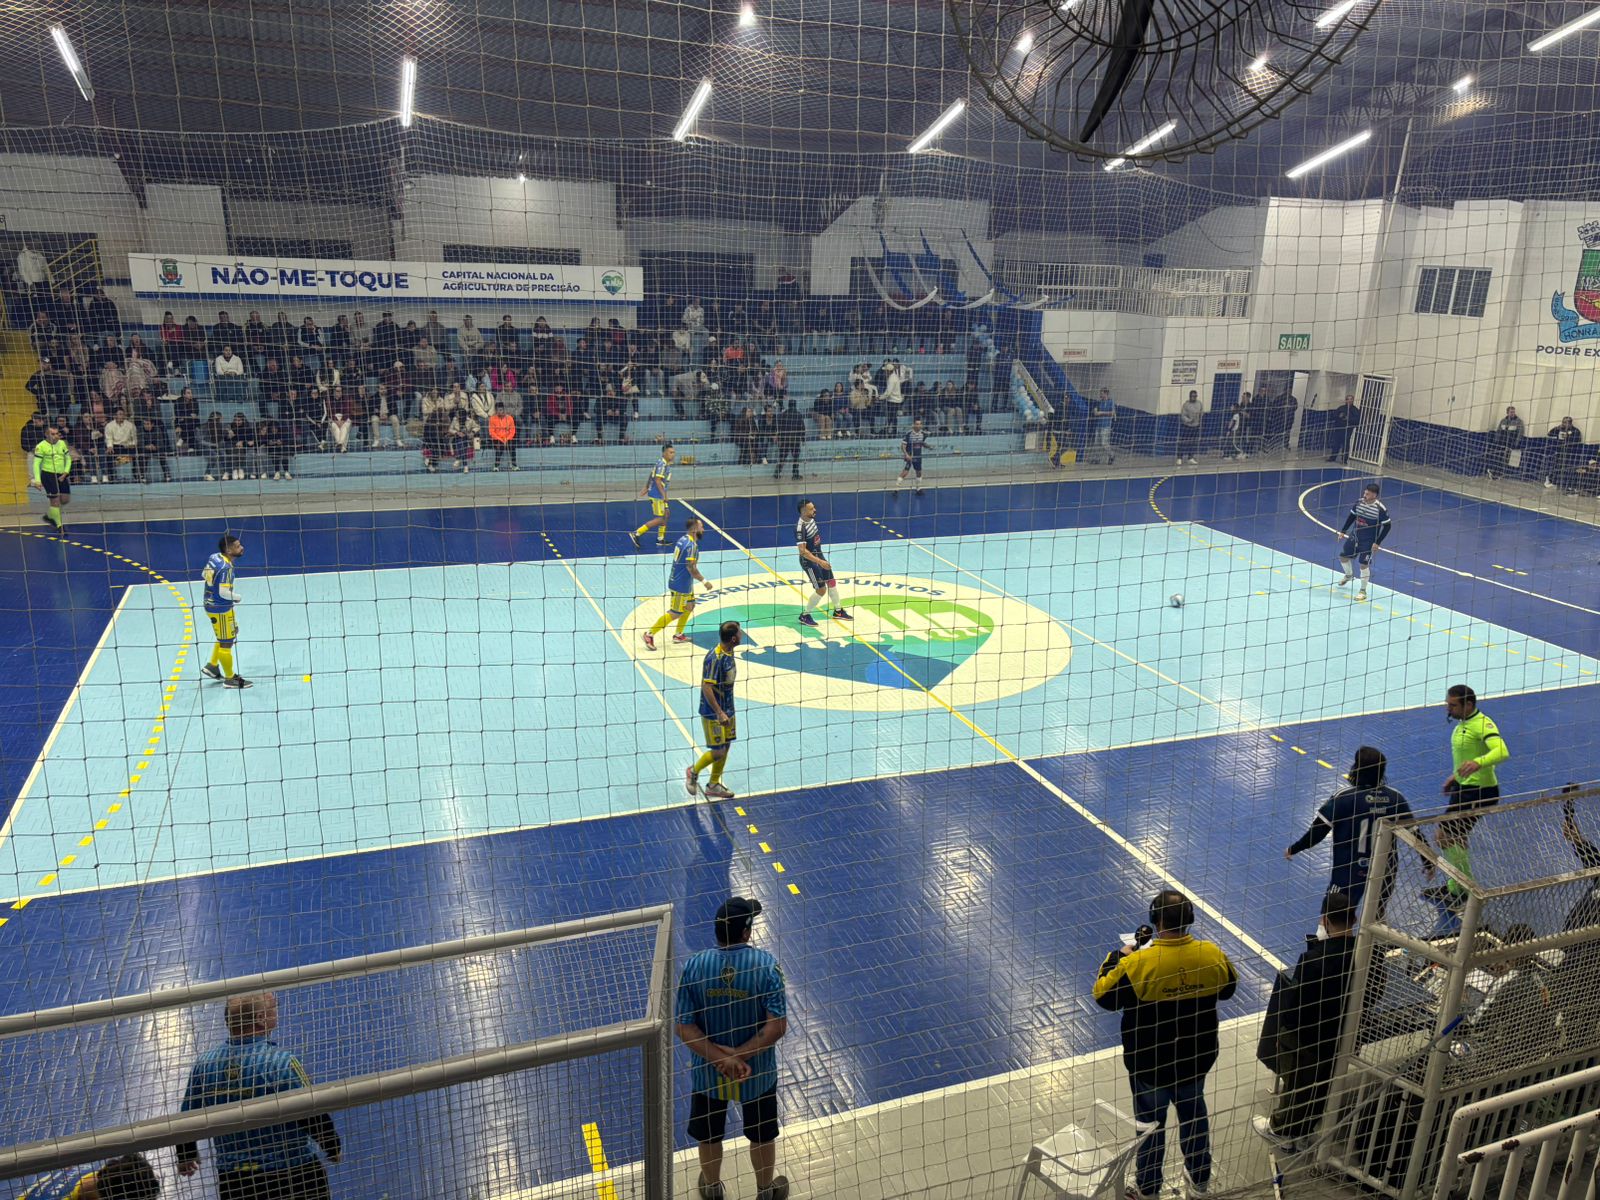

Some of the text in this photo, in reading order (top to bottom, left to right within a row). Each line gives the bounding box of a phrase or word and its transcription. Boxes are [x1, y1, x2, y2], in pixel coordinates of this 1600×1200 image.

[211, 262, 409, 291] NÃO-ME-TOQUE
[441, 271, 554, 281] CAPITAL NACIONAL DA
[443, 282, 580, 293] AGRICULTURA DE PRECISÃO
[1280, 334, 1309, 350] SAÍDA
[1536, 345, 1581, 357] PODER
[837, 577, 946, 597] JUNTOS
